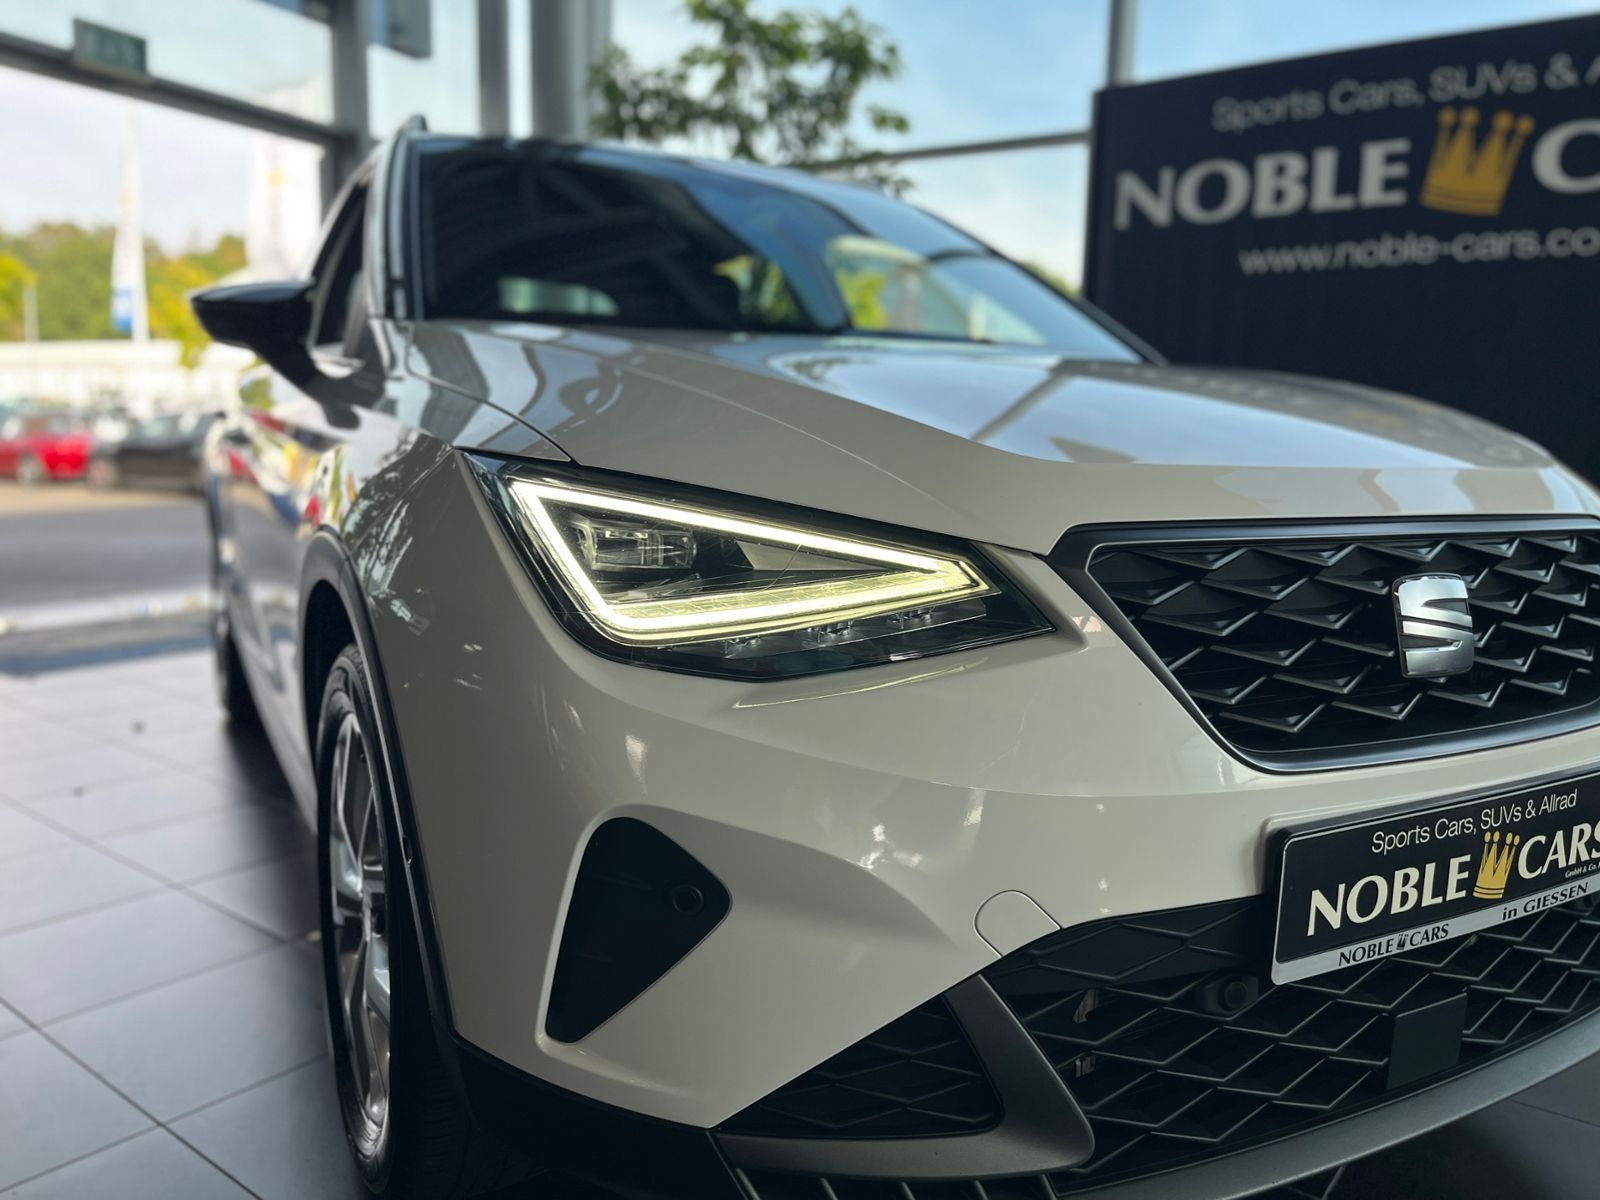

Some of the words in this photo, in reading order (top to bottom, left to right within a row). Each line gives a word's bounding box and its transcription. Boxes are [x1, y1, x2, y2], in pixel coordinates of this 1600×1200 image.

[1212, 90, 1325, 134] Sports
[1429, 60, 1537, 101] SUVs
[1545, 53, 1579, 90] &
[1114, 138, 1411, 230] NOBLE
[1371, 825, 1430, 855] Sports
[1435, 817, 1477, 839] Cars,
[1480, 803, 1522, 830] SUVs
[1525, 799, 1536, 818] &
[1539, 788, 1578, 816] Allrad
[1307, 854, 1471, 936] NOBLE
[1338, 938, 1394, 967] NOBLE
[1409, 923, 1449, 946] CARS
[1502, 907, 1517, 920] in
[1523, 882, 1588, 913] GIESSEN
